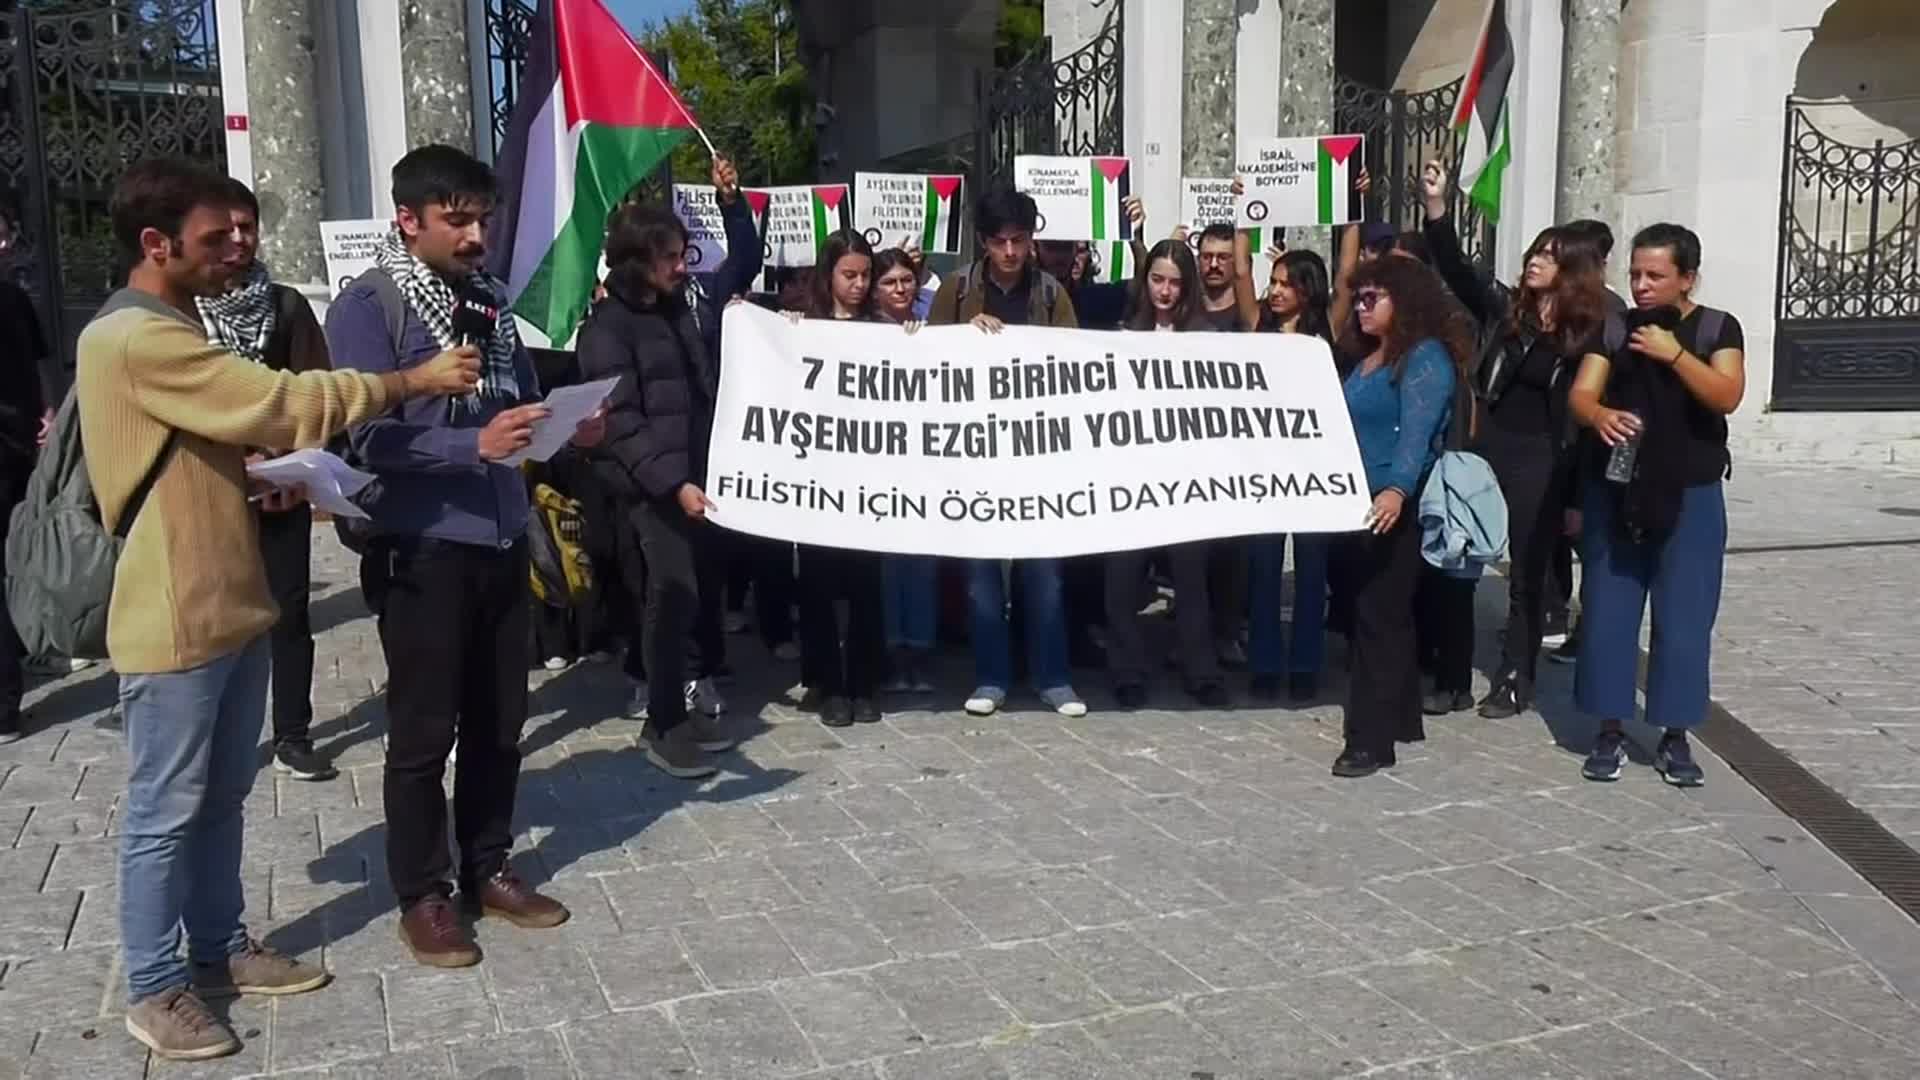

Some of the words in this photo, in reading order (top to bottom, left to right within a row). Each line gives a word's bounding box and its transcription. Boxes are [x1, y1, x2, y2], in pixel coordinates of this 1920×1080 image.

[1260, 148, 1295, 160] İSRAİL
[1255, 175, 1299, 186] BOYKOT
[1189, 182, 1232, 193] NEHİRD
[677, 188, 714, 204] FİLİST
[882, 193, 922, 204] YOLUNDA
[1197, 205, 1235, 217] ÖZGÜR
[802, 357, 824, 390] 7
[838, 359, 975, 402] EKİM'İN
[989, 353, 1117, 401] BİRİNCİ
[1128, 358, 1269, 391] YILINDA
[741, 405, 908, 459] AYŞENUR
[922, 411, 1072, 458] EZGİ'NİN
[1084, 406, 1323, 448] YOLUNDAYIZ!
[718, 470, 845, 512] FİLİSTİN
[858, 485, 926, 522] İÇİN
[939, 482, 1097, 522] ÖĞRENCİ
[1110, 472, 1358, 513] DAYANIŞMASI
